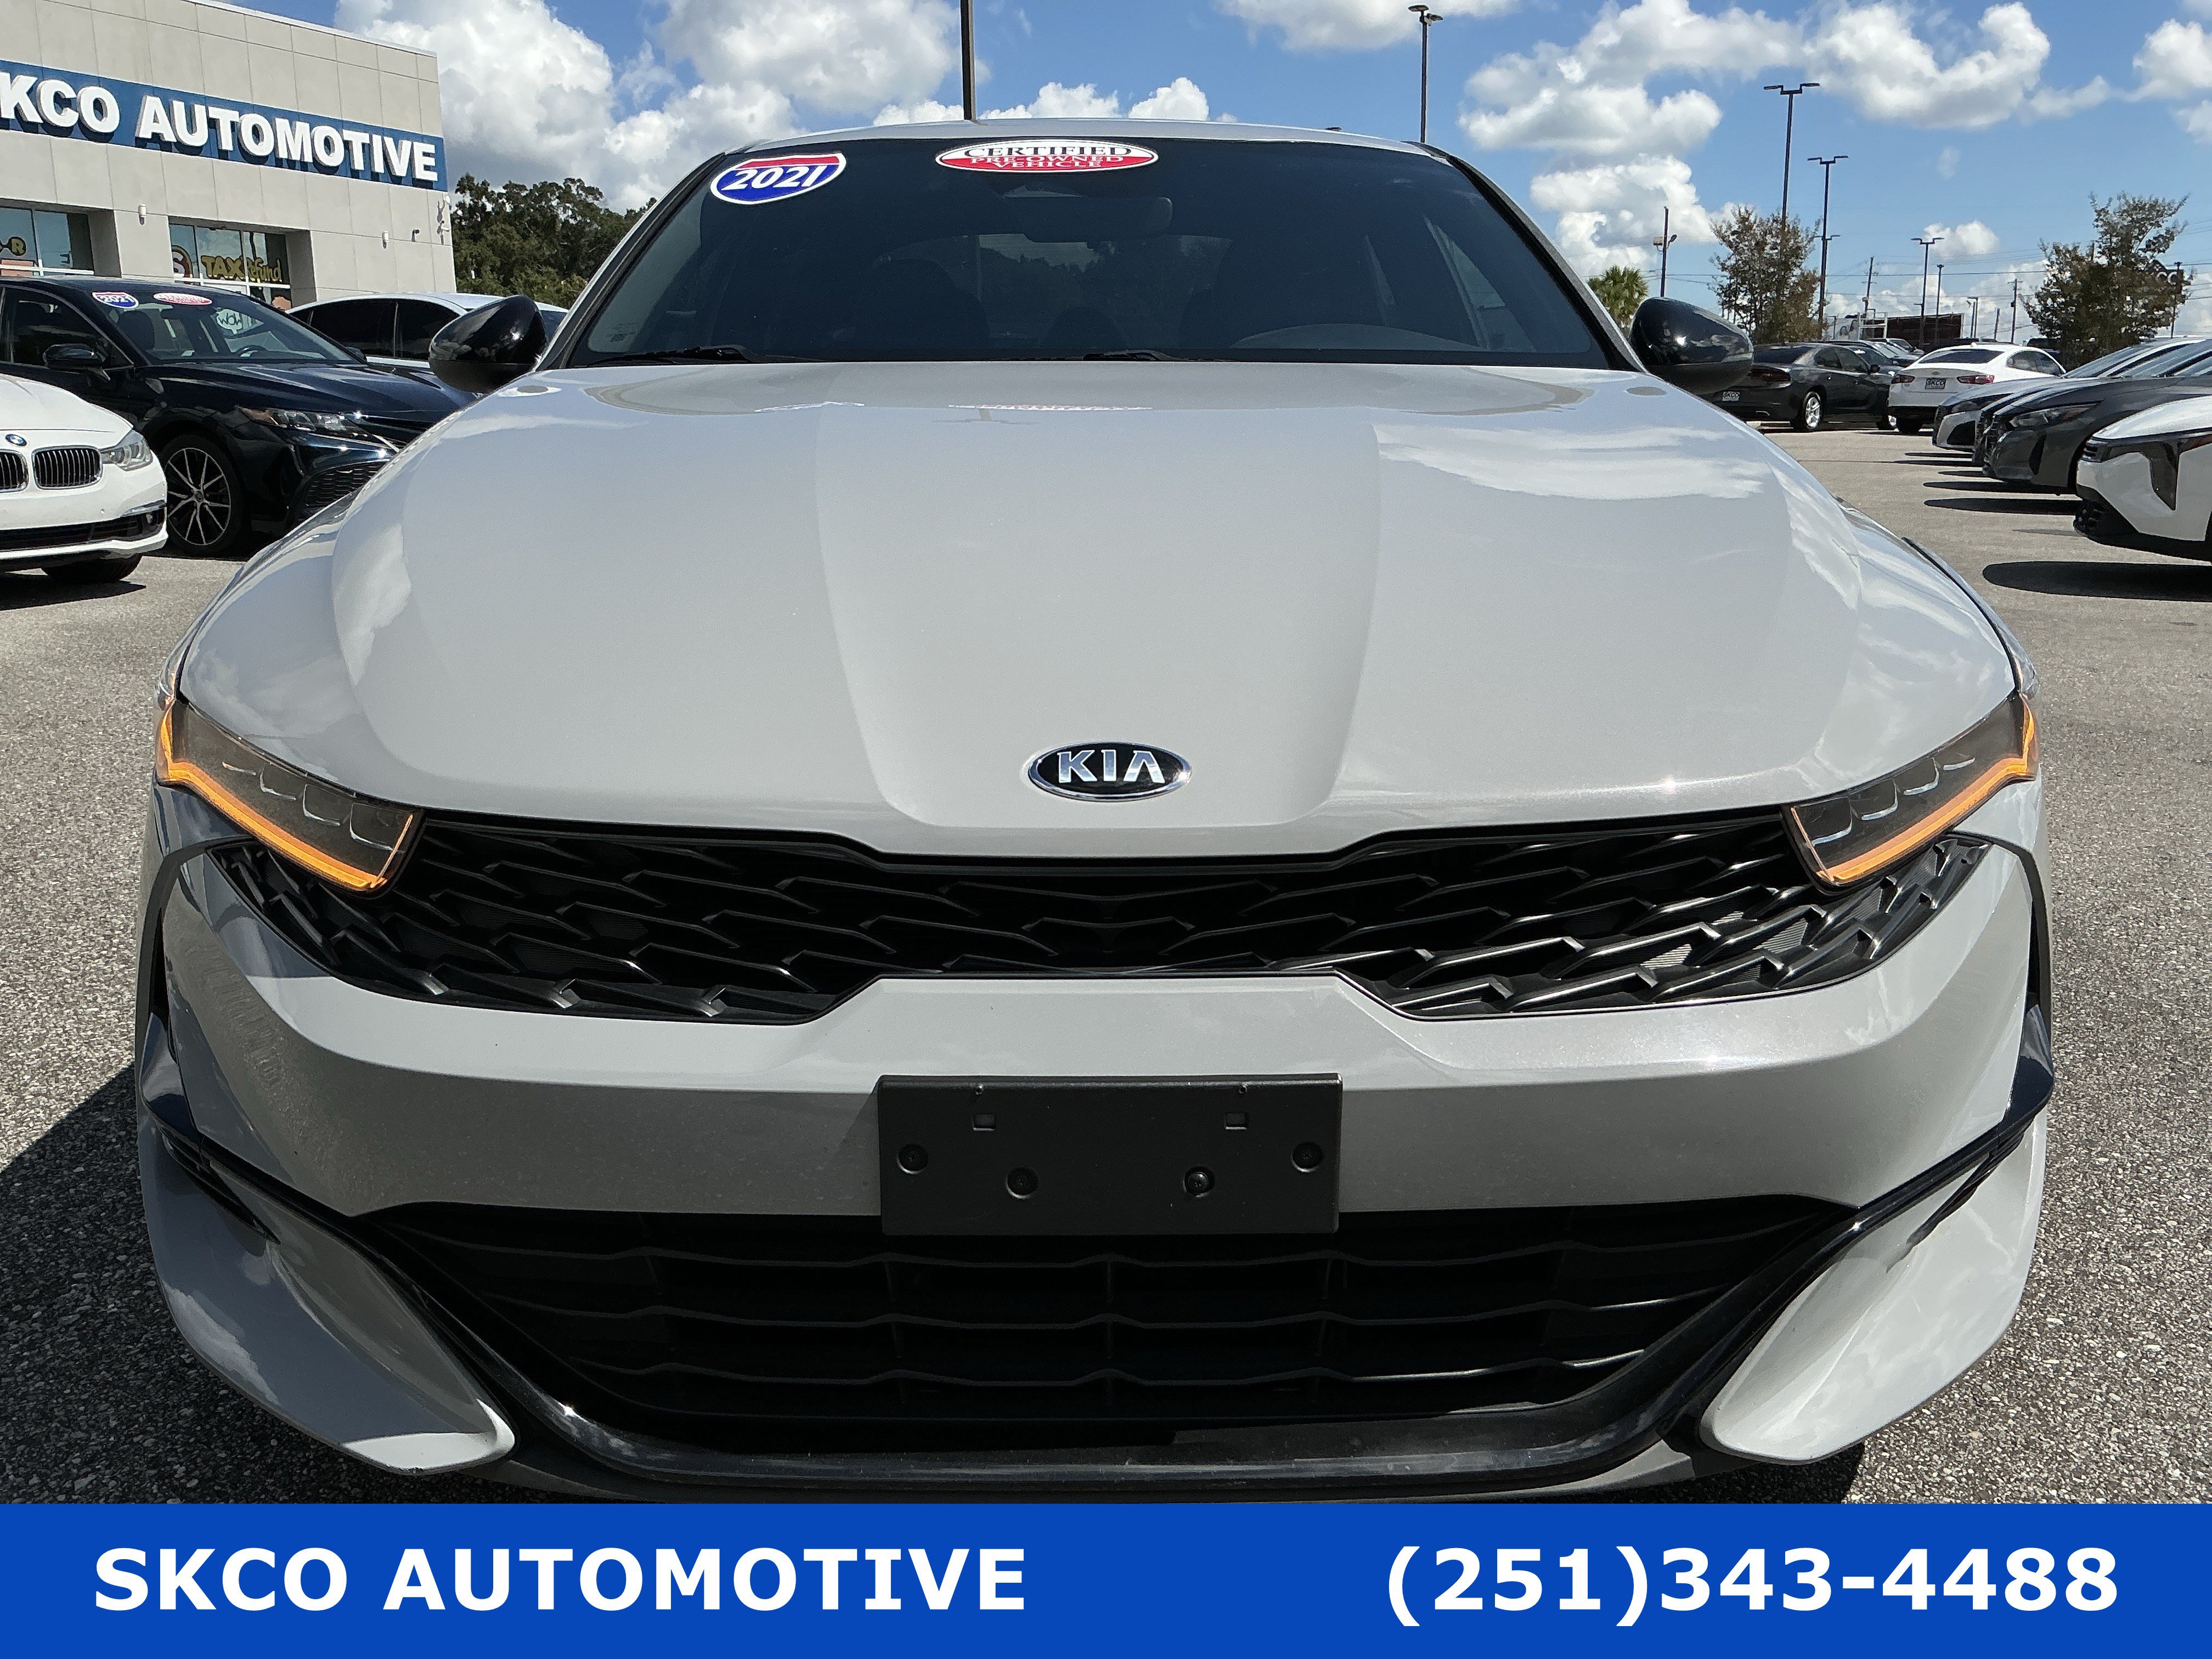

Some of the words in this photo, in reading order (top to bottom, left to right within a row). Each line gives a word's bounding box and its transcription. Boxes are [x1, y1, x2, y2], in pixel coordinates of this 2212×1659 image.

[136, 95, 438, 182] AUTOMOTIVE
[964, 146, 1131, 157] CERTIFIED
[721, 165, 827, 191] 2021
[201, 256, 245, 280] TAX
[1057, 749, 1165, 783] KIA
